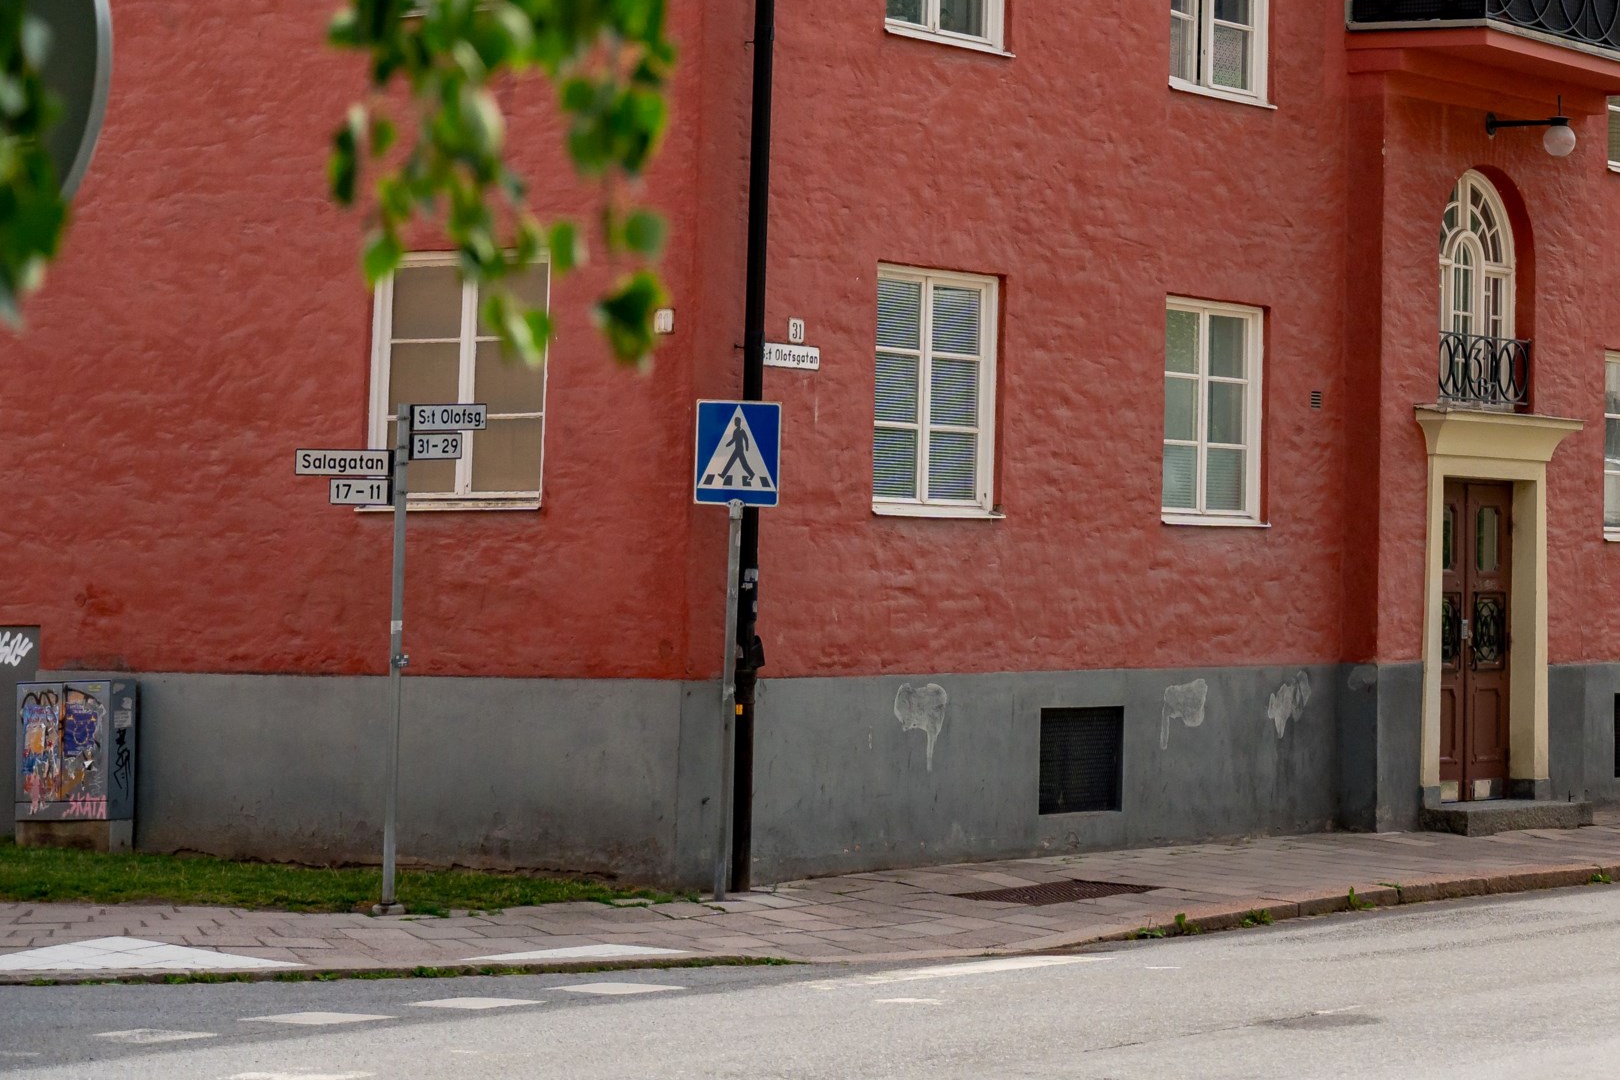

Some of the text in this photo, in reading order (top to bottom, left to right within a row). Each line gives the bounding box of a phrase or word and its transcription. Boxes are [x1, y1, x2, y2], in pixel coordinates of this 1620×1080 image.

[792, 322, 803, 340] 31
[775, 348, 818, 365] Olofsgatan
[418, 409, 485, 428] S:t Olofsg.
[301, 453, 384, 473] Salagatan
